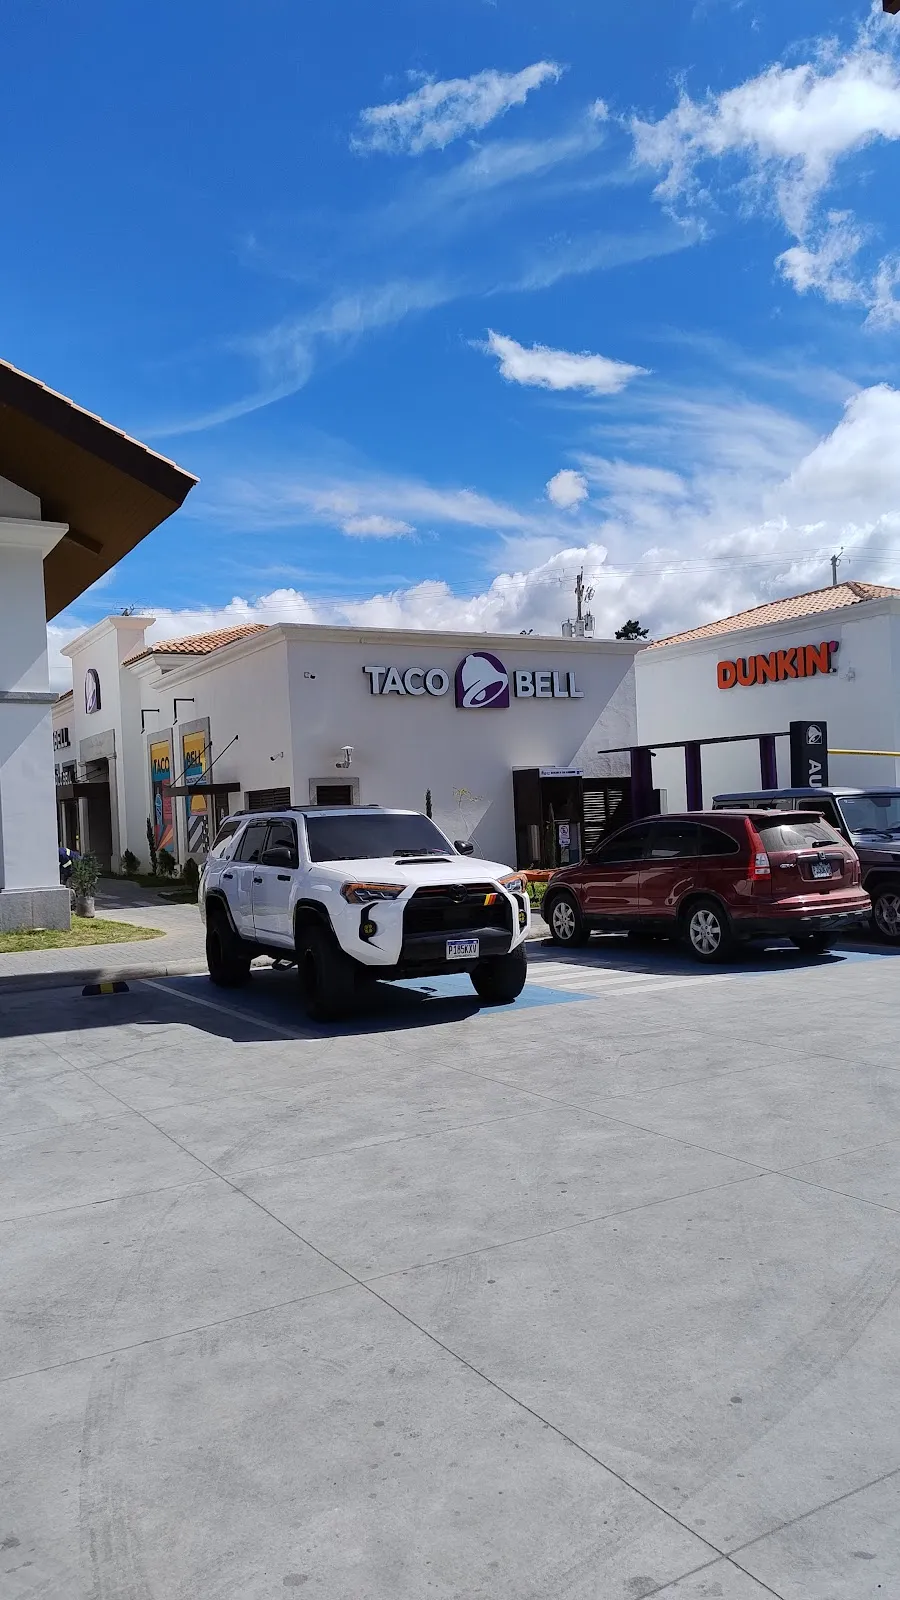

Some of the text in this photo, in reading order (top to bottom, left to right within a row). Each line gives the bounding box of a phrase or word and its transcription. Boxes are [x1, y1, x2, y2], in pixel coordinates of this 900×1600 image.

[362, 665, 584, 698] TACO BELL
[153, 756, 170, 774] TACO
